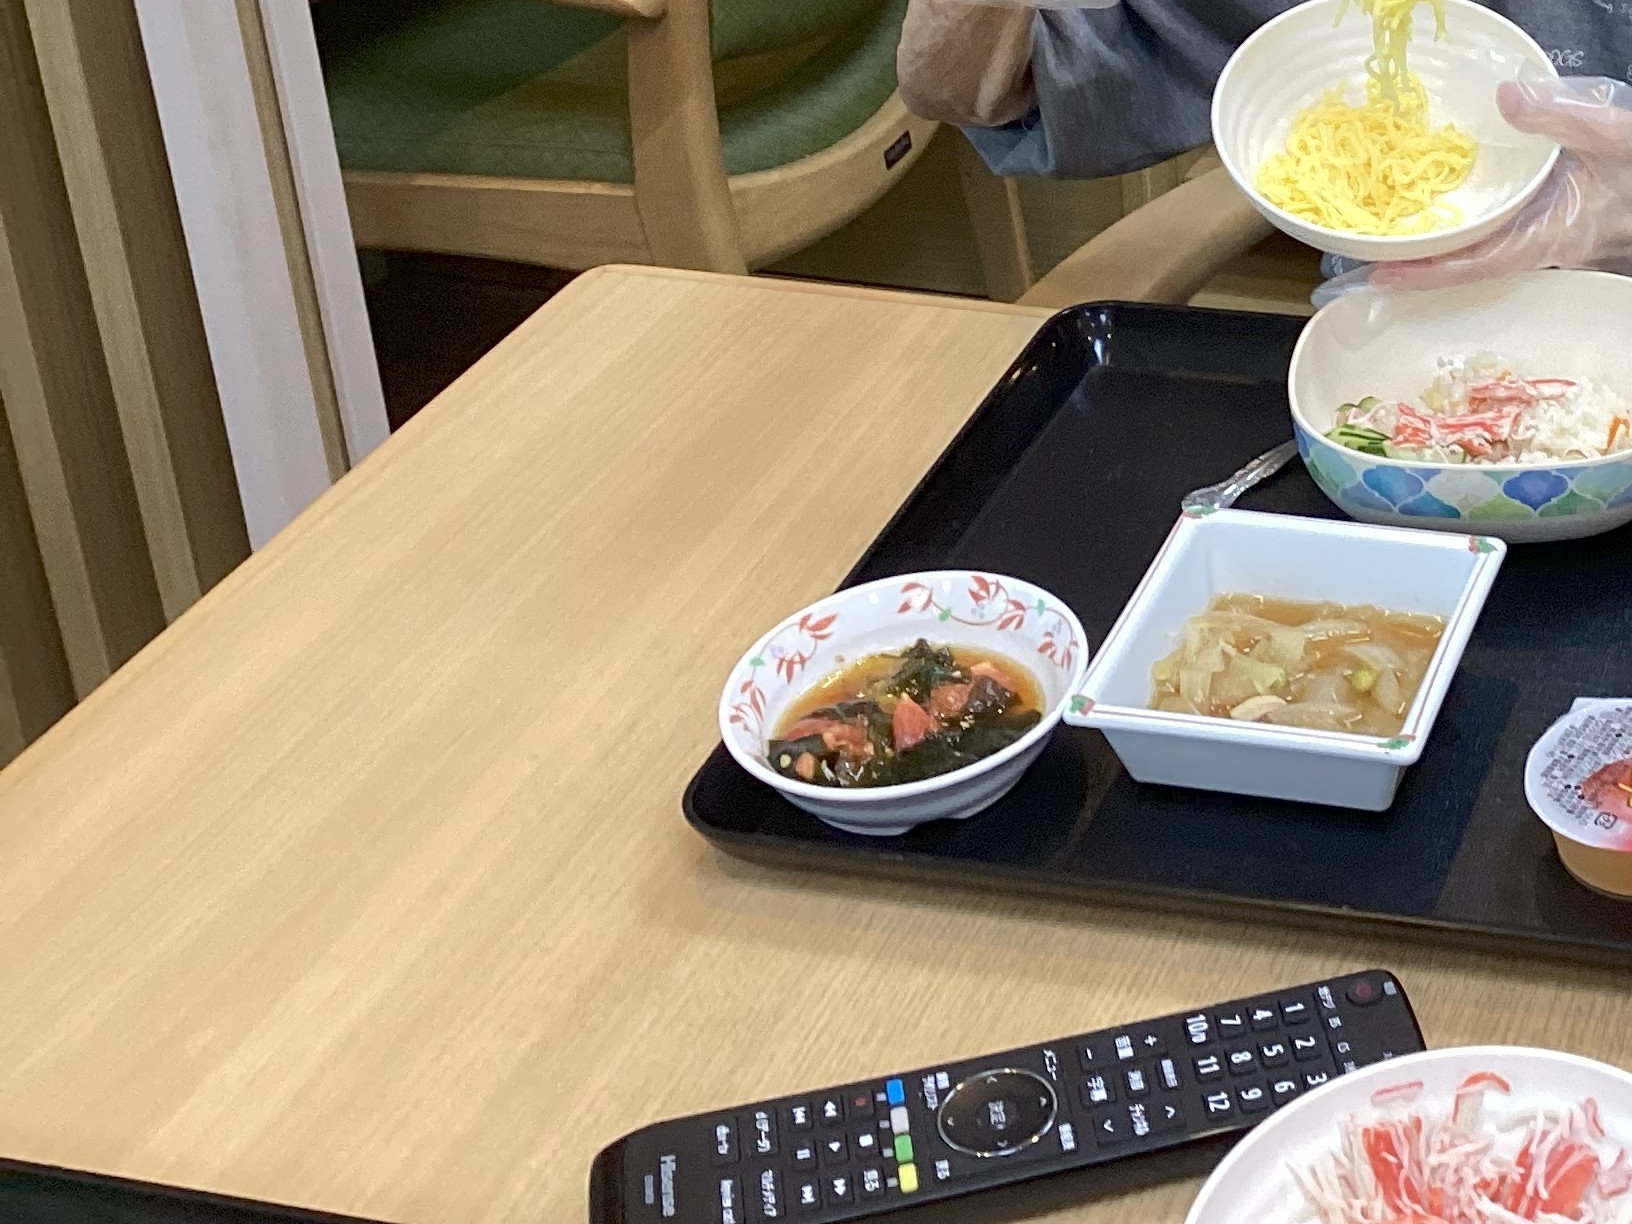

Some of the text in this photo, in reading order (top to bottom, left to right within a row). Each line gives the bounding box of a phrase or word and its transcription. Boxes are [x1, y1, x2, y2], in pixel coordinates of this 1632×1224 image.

[1197, 1056, 1219, 1074] 11
[1220, 1014, 1262, 1101] 7 8 9
[1252, 1009, 1294, 1093] 4 5 6
[1284, 1002, 1327, 1085] 1 2 3
[1207, 1091, 1230, 1112] 12
[660, 1155, 677, 1218] Hisense
